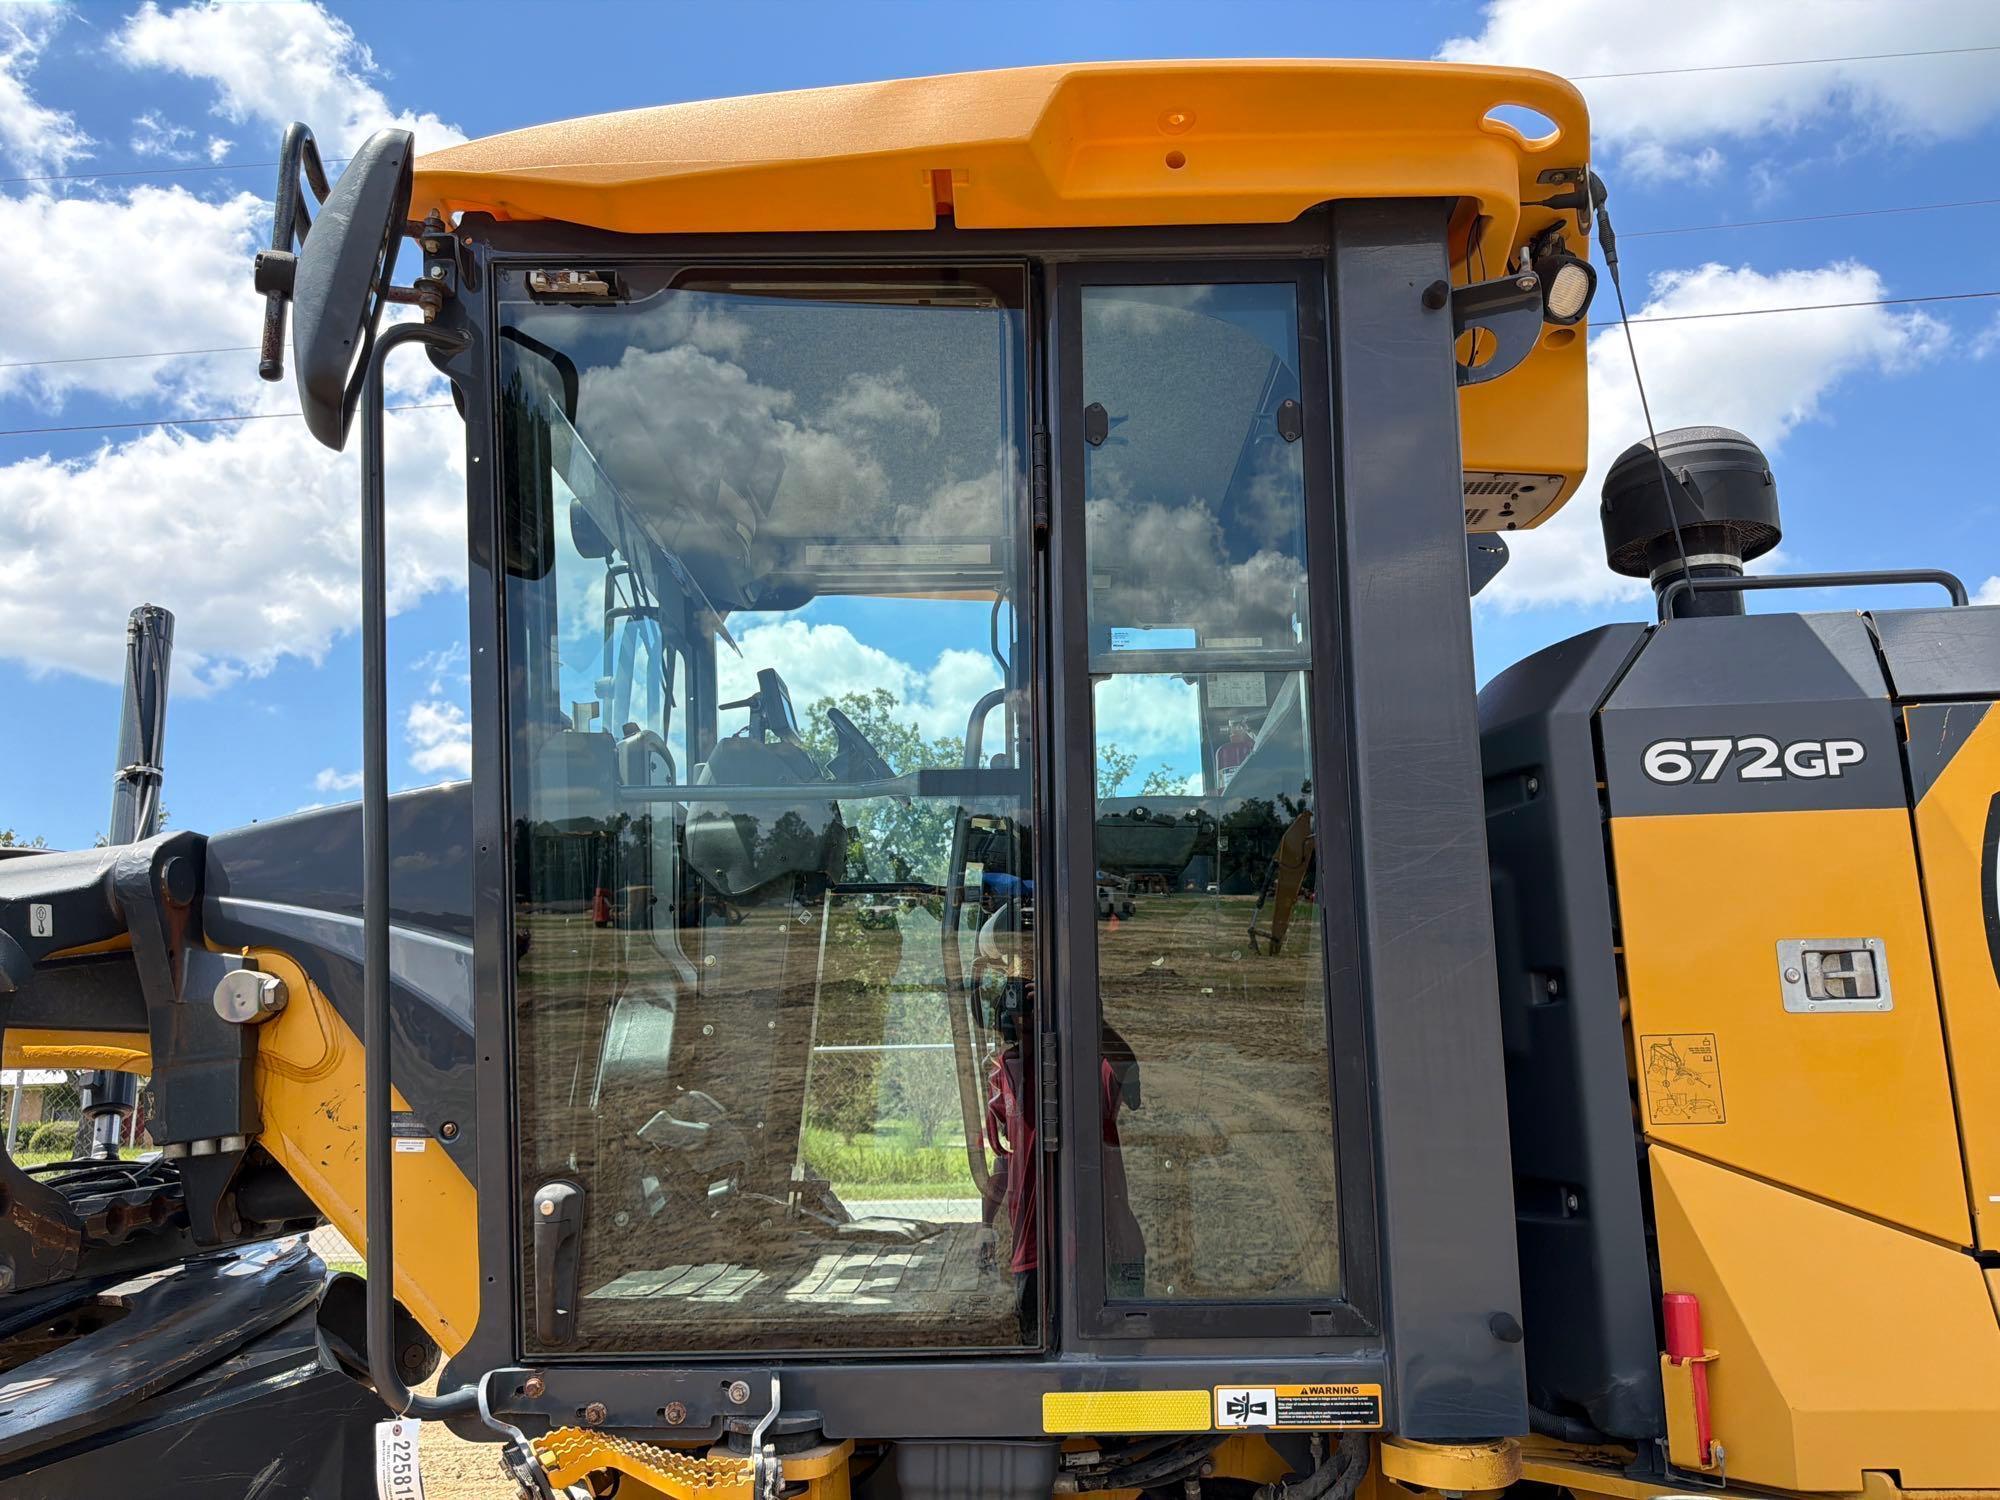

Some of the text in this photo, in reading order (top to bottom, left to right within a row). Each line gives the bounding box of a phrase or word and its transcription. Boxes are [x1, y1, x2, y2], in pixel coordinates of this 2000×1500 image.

[1642, 736, 1866, 783] 672GP
[1309, 1386, 1360, 1395] WARNING
[394, 1440, 415, 1500] 22581
